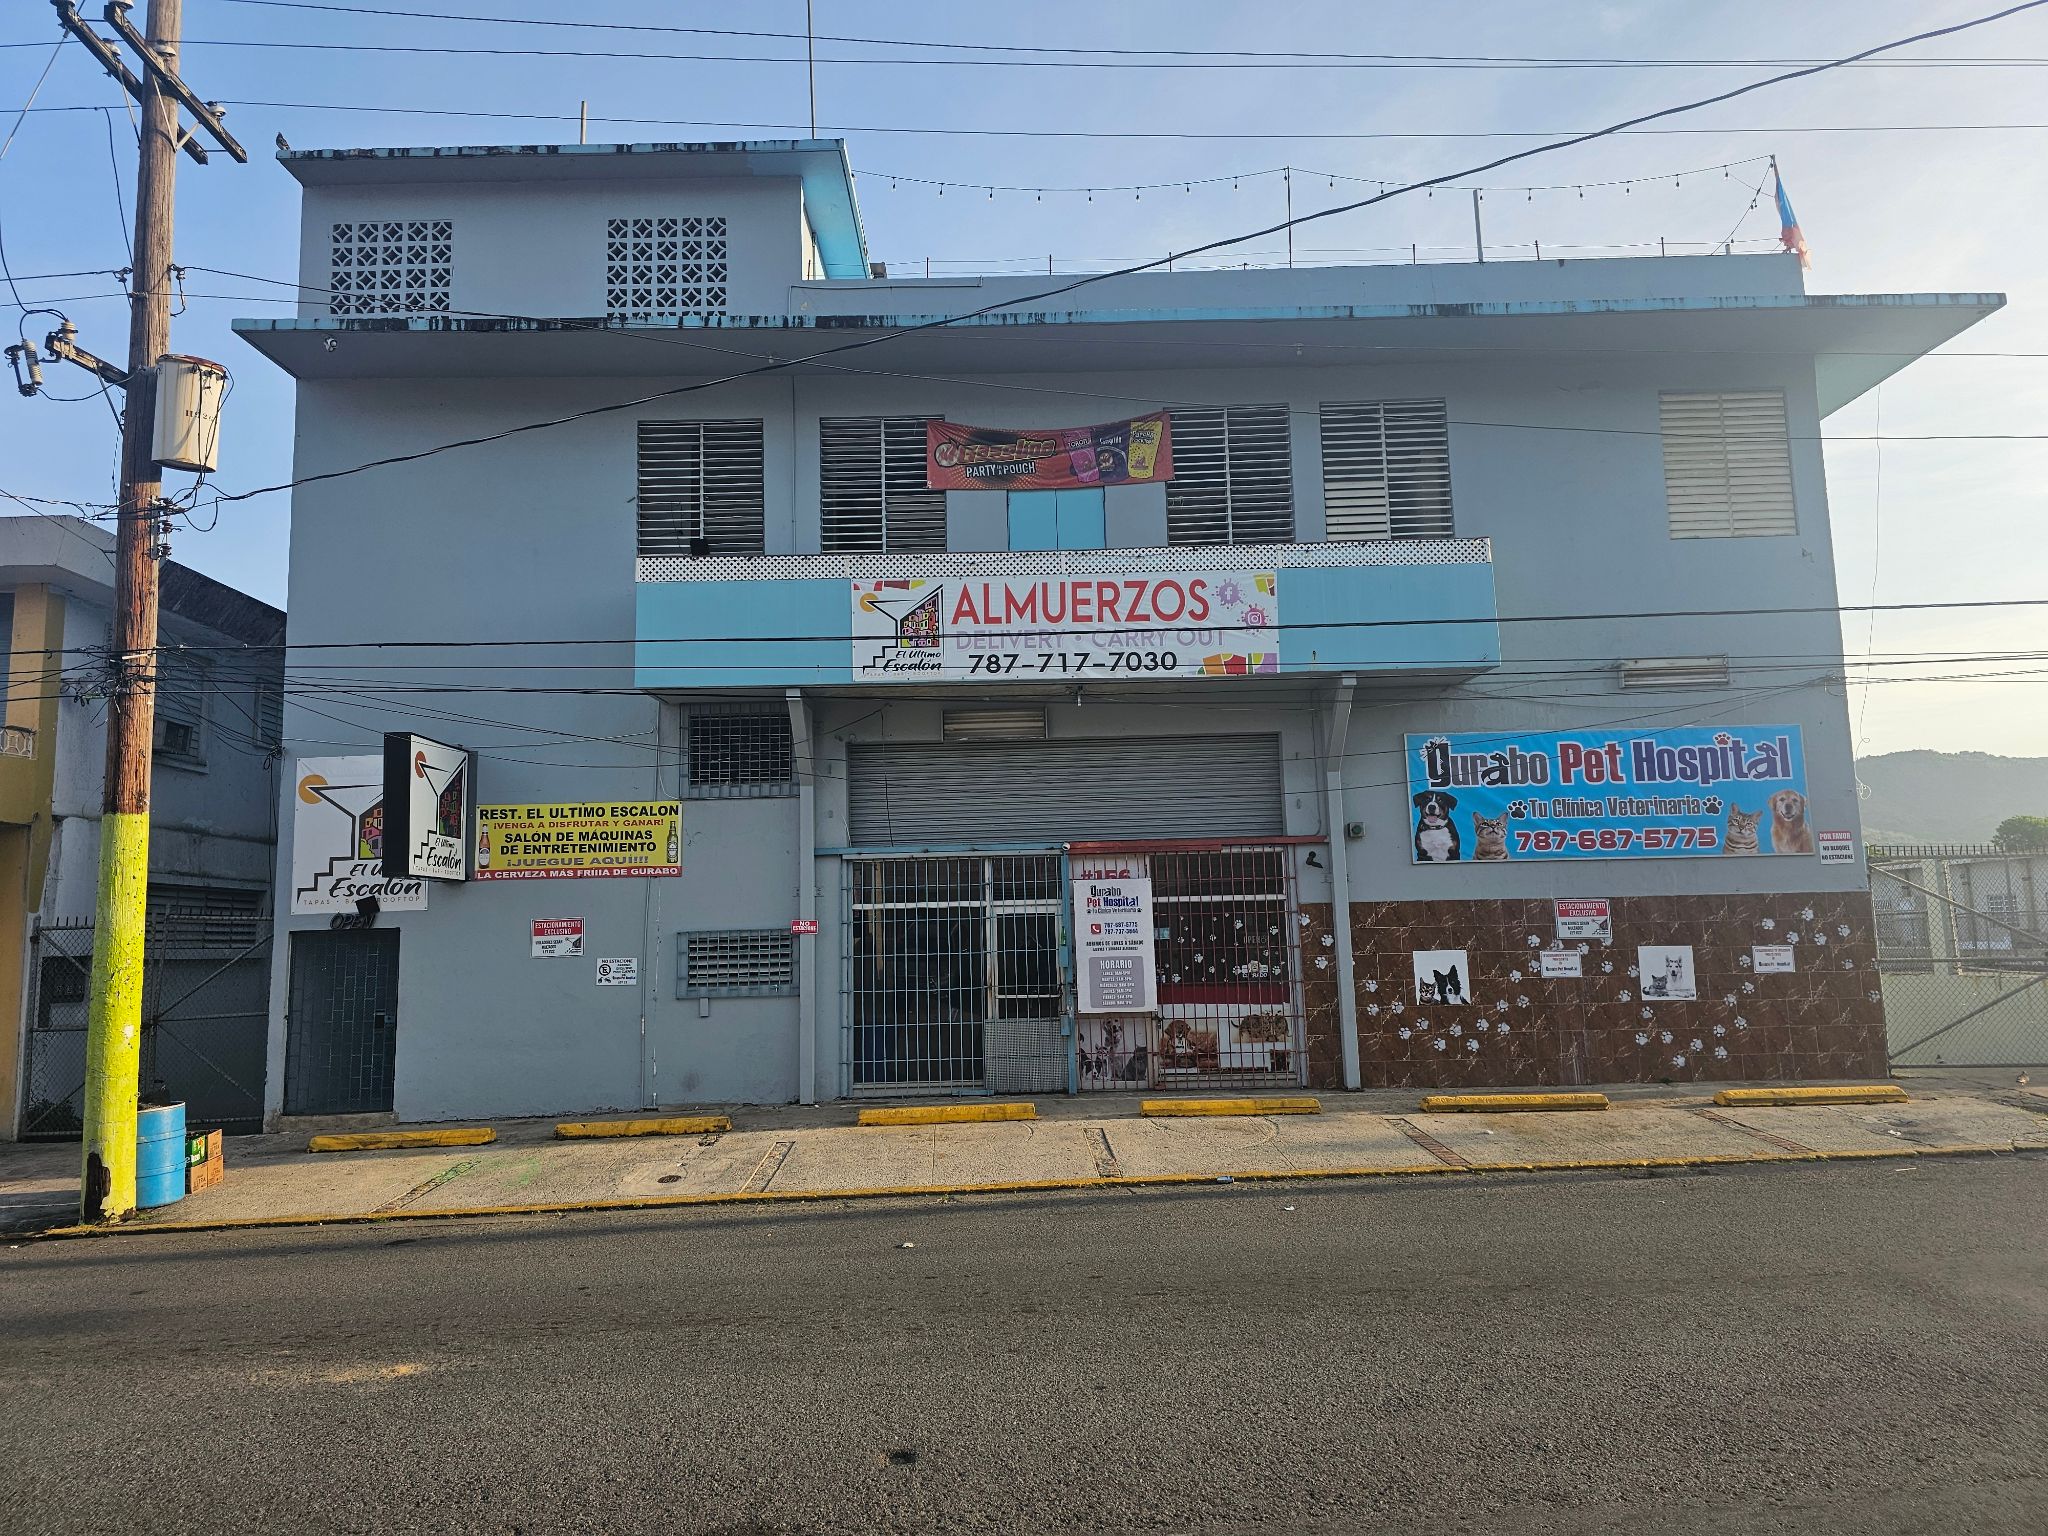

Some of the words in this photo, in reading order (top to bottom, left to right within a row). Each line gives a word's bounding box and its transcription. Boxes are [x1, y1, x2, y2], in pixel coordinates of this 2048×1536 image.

[966, 464, 996, 478] PARTY
[1003, 462, 1036, 475] POUCH
[951, 578, 1210, 625] ALMUERZOS
[956, 628, 1064, 650] DELIVERY
[1091, 628, 1169, 648] CARRY
[1176, 627, 1225, 646] OUT
[895, 650, 907, 659] El
[968, 651, 1178, 674] 787-717-7030
[1558, 742, 1626, 785] Pet
[1631, 736, 1792, 785] Hospital
[479, 808, 522, 820] REST.
[526, 808, 544, 819] EL
[549, 807, 606, 819] ULTIMO
[610, 805, 679, 817] ESCALON
[1528, 799, 1548, 818] Tu
[1552, 797, 1604, 818] Clínica
[1606, 796, 1702, 817] Veterinaria
[493, 822, 535, 830] ¡VENGA
[537, 821, 545, 829] A
[548, 820, 609, 829] DISFRUTAR
[623, 818, 664, 827] GANAR!
[504, 830, 551, 843] SALÓN
[556, 832, 574, 842] DE
[578, 829, 653, 842] MÁQUINAS
[1515, 827, 1717, 851] 787-687-5775
[500, 845, 519, 855] DE
[523, 842, 657, 855] ENTRETENIMIENTO
[426, 846, 462, 871] Escalón
[506, 857, 584, 867] ¡JUEGUE
[349, 863, 367, 877] El
[477, 871, 492, 879] LA
[494, 870, 547, 879] CERVEZA
[549, 868, 574, 878] MÁS
[613, 867, 628, 876] DE
[630, 867, 678, 875] GURABO
[328, 876, 422, 898] Escalón
[1087, 897, 1102, 907] Pet
[1103, 896, 1139, 907] Hospital
[1558, 902, 1606, 910] ESTACIONAMIENTO
[330, 911, 376, 929] OPEN
[535, 921, 582, 929] ESTACIONAMIENTO
[544, 928, 572, 936] EXCLUSIVO
[1100, 959, 1133, 969] HORARIO
